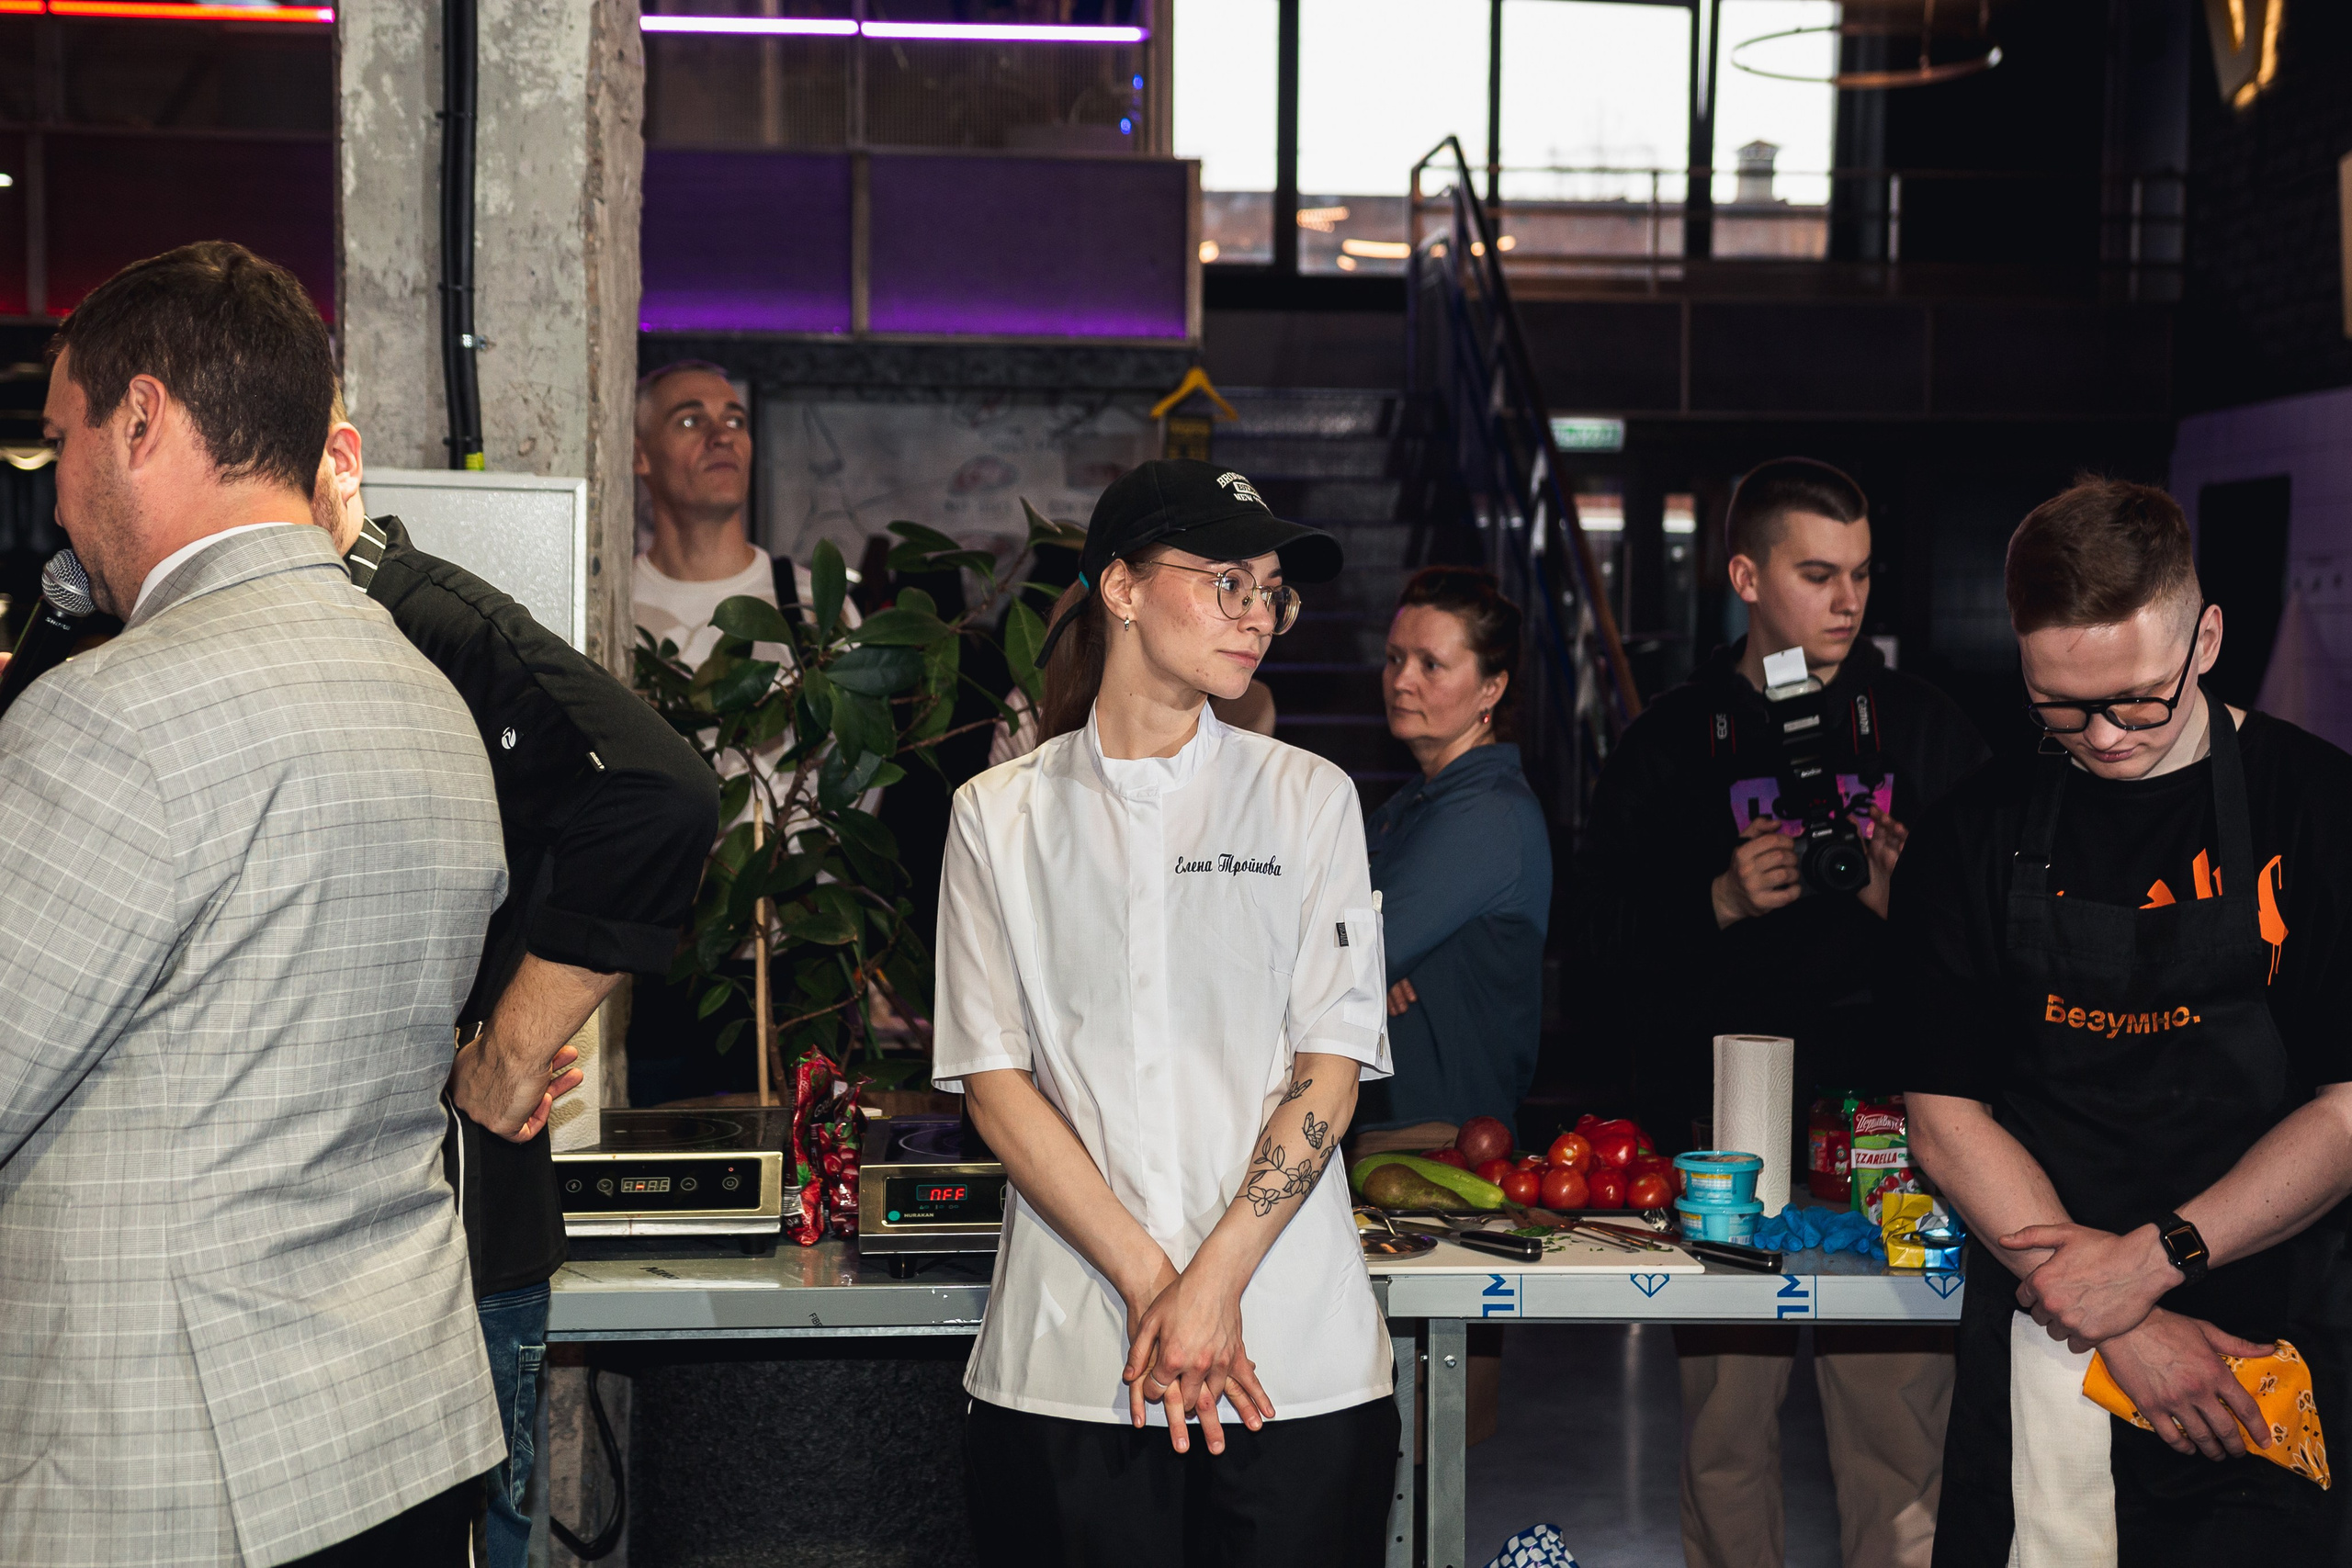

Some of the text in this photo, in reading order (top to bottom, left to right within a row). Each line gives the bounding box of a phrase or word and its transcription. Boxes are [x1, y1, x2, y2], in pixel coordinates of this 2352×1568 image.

[1175, 852, 1283, 876] Елена Тройнова
[2044, 993, 2201, 1040] Безумно.
[930, 1188, 966, 1201] OFF
